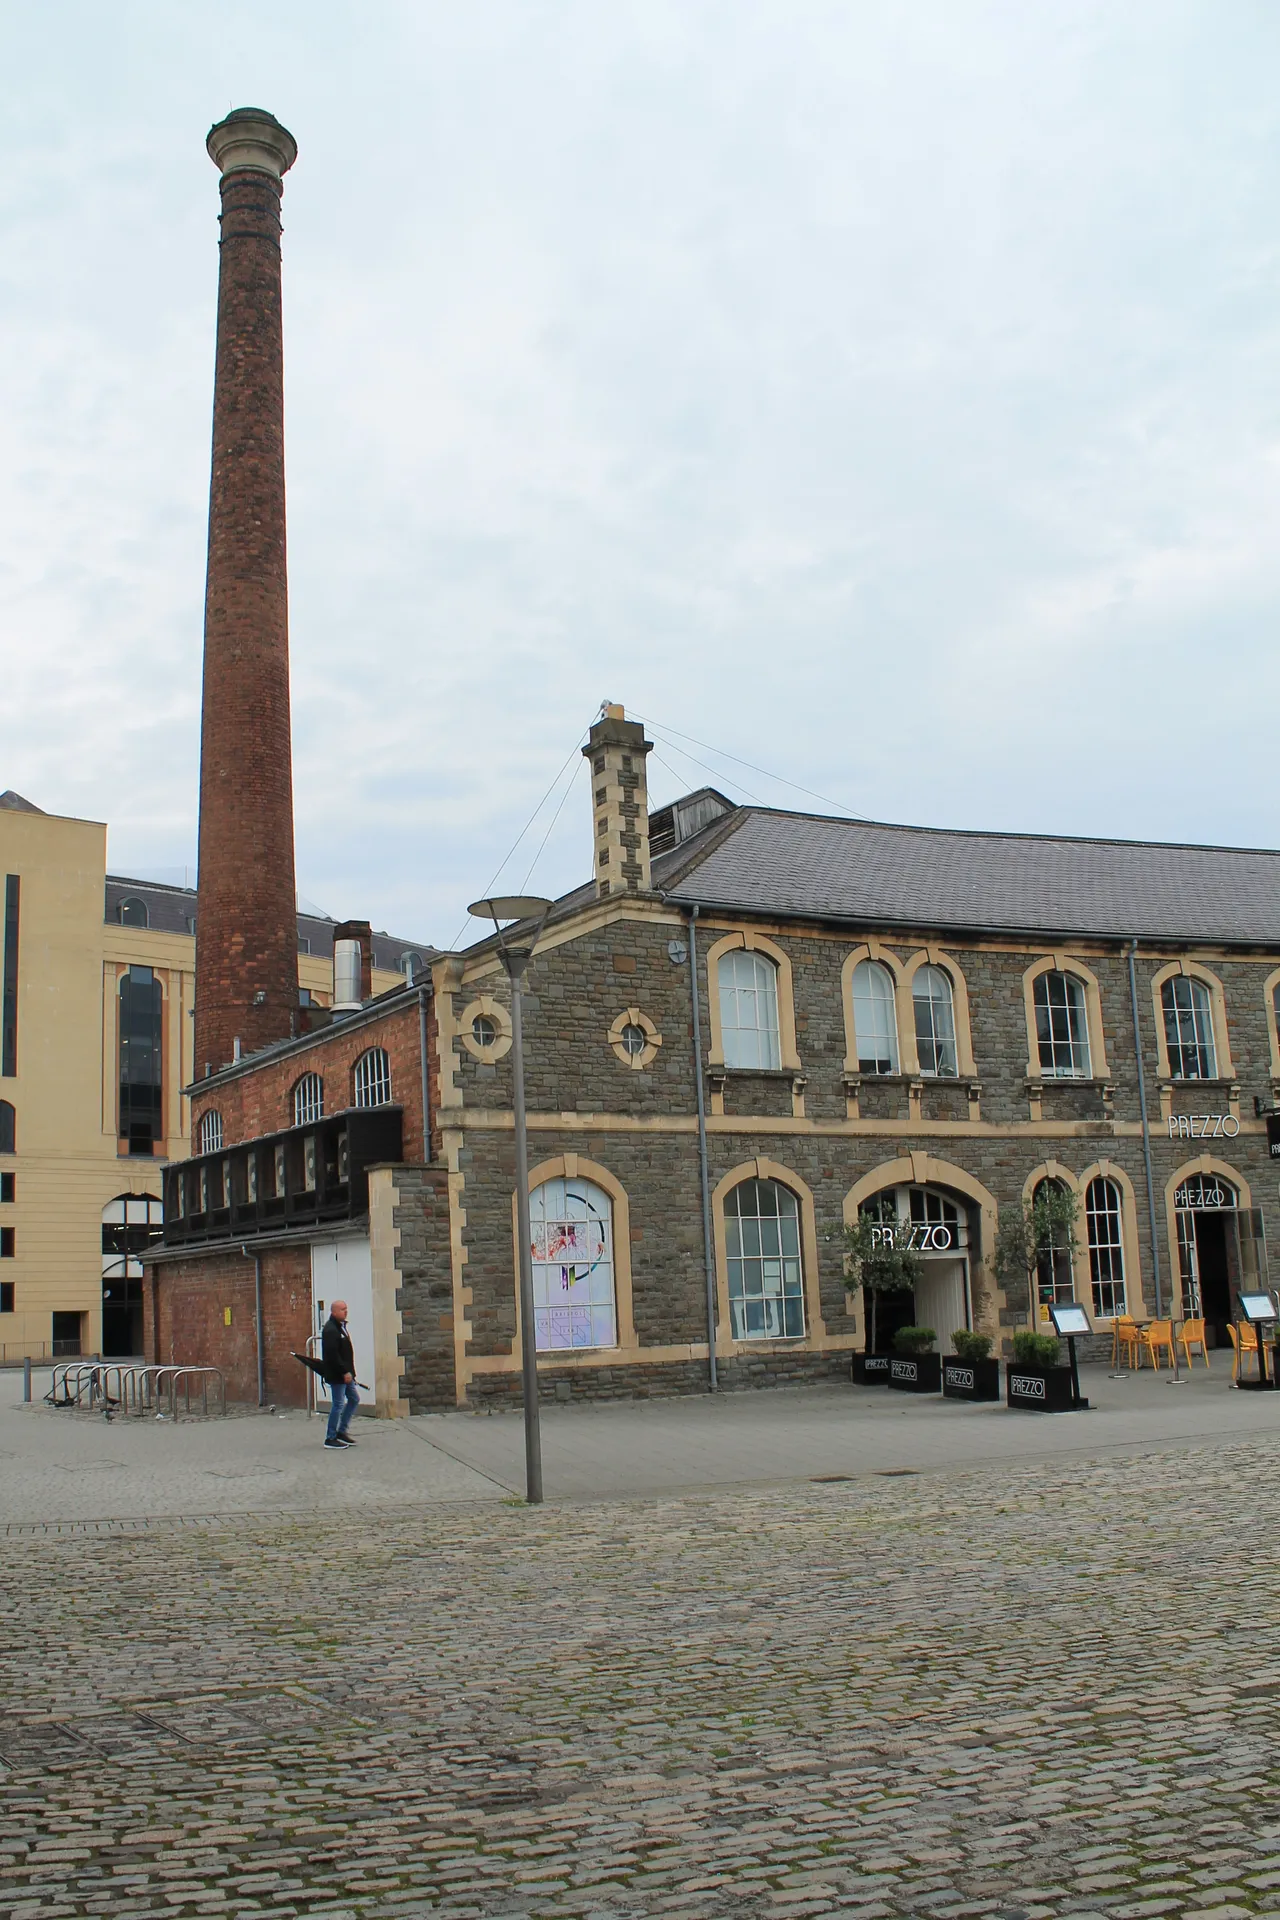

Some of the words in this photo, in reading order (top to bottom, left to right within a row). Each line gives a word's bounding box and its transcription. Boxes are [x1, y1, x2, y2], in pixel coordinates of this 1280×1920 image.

[1168, 1114, 1240, 1139] PREZZO
[1174, 1189, 1225, 1206] PREZZO
[891, 1362, 916, 1378] PREZZO
[947, 1369, 972, 1386] PREZZO
[1012, 1378, 1043, 1396] PREZZO
